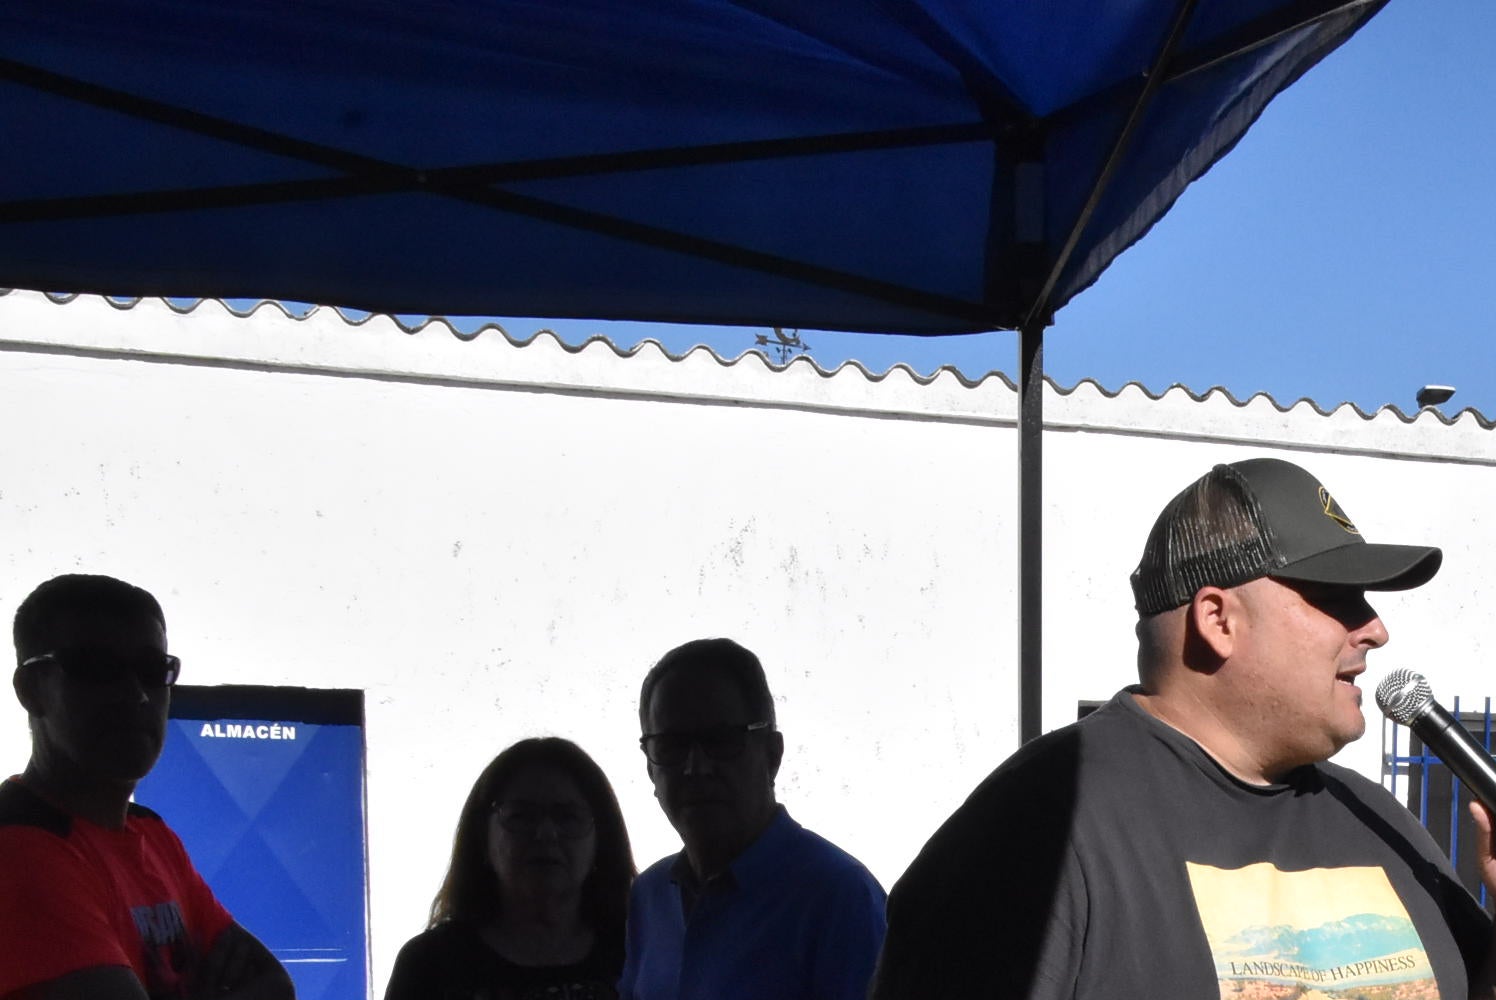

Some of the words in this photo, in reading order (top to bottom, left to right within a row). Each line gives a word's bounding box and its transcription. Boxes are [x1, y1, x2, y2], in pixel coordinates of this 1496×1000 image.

[200, 723, 296, 740] ALMACÉN
[1230, 961, 1311, 981] LANDSCAPE
[1310, 968, 1327, 982] OF
[1330, 955, 1416, 981] HAPPINESS
